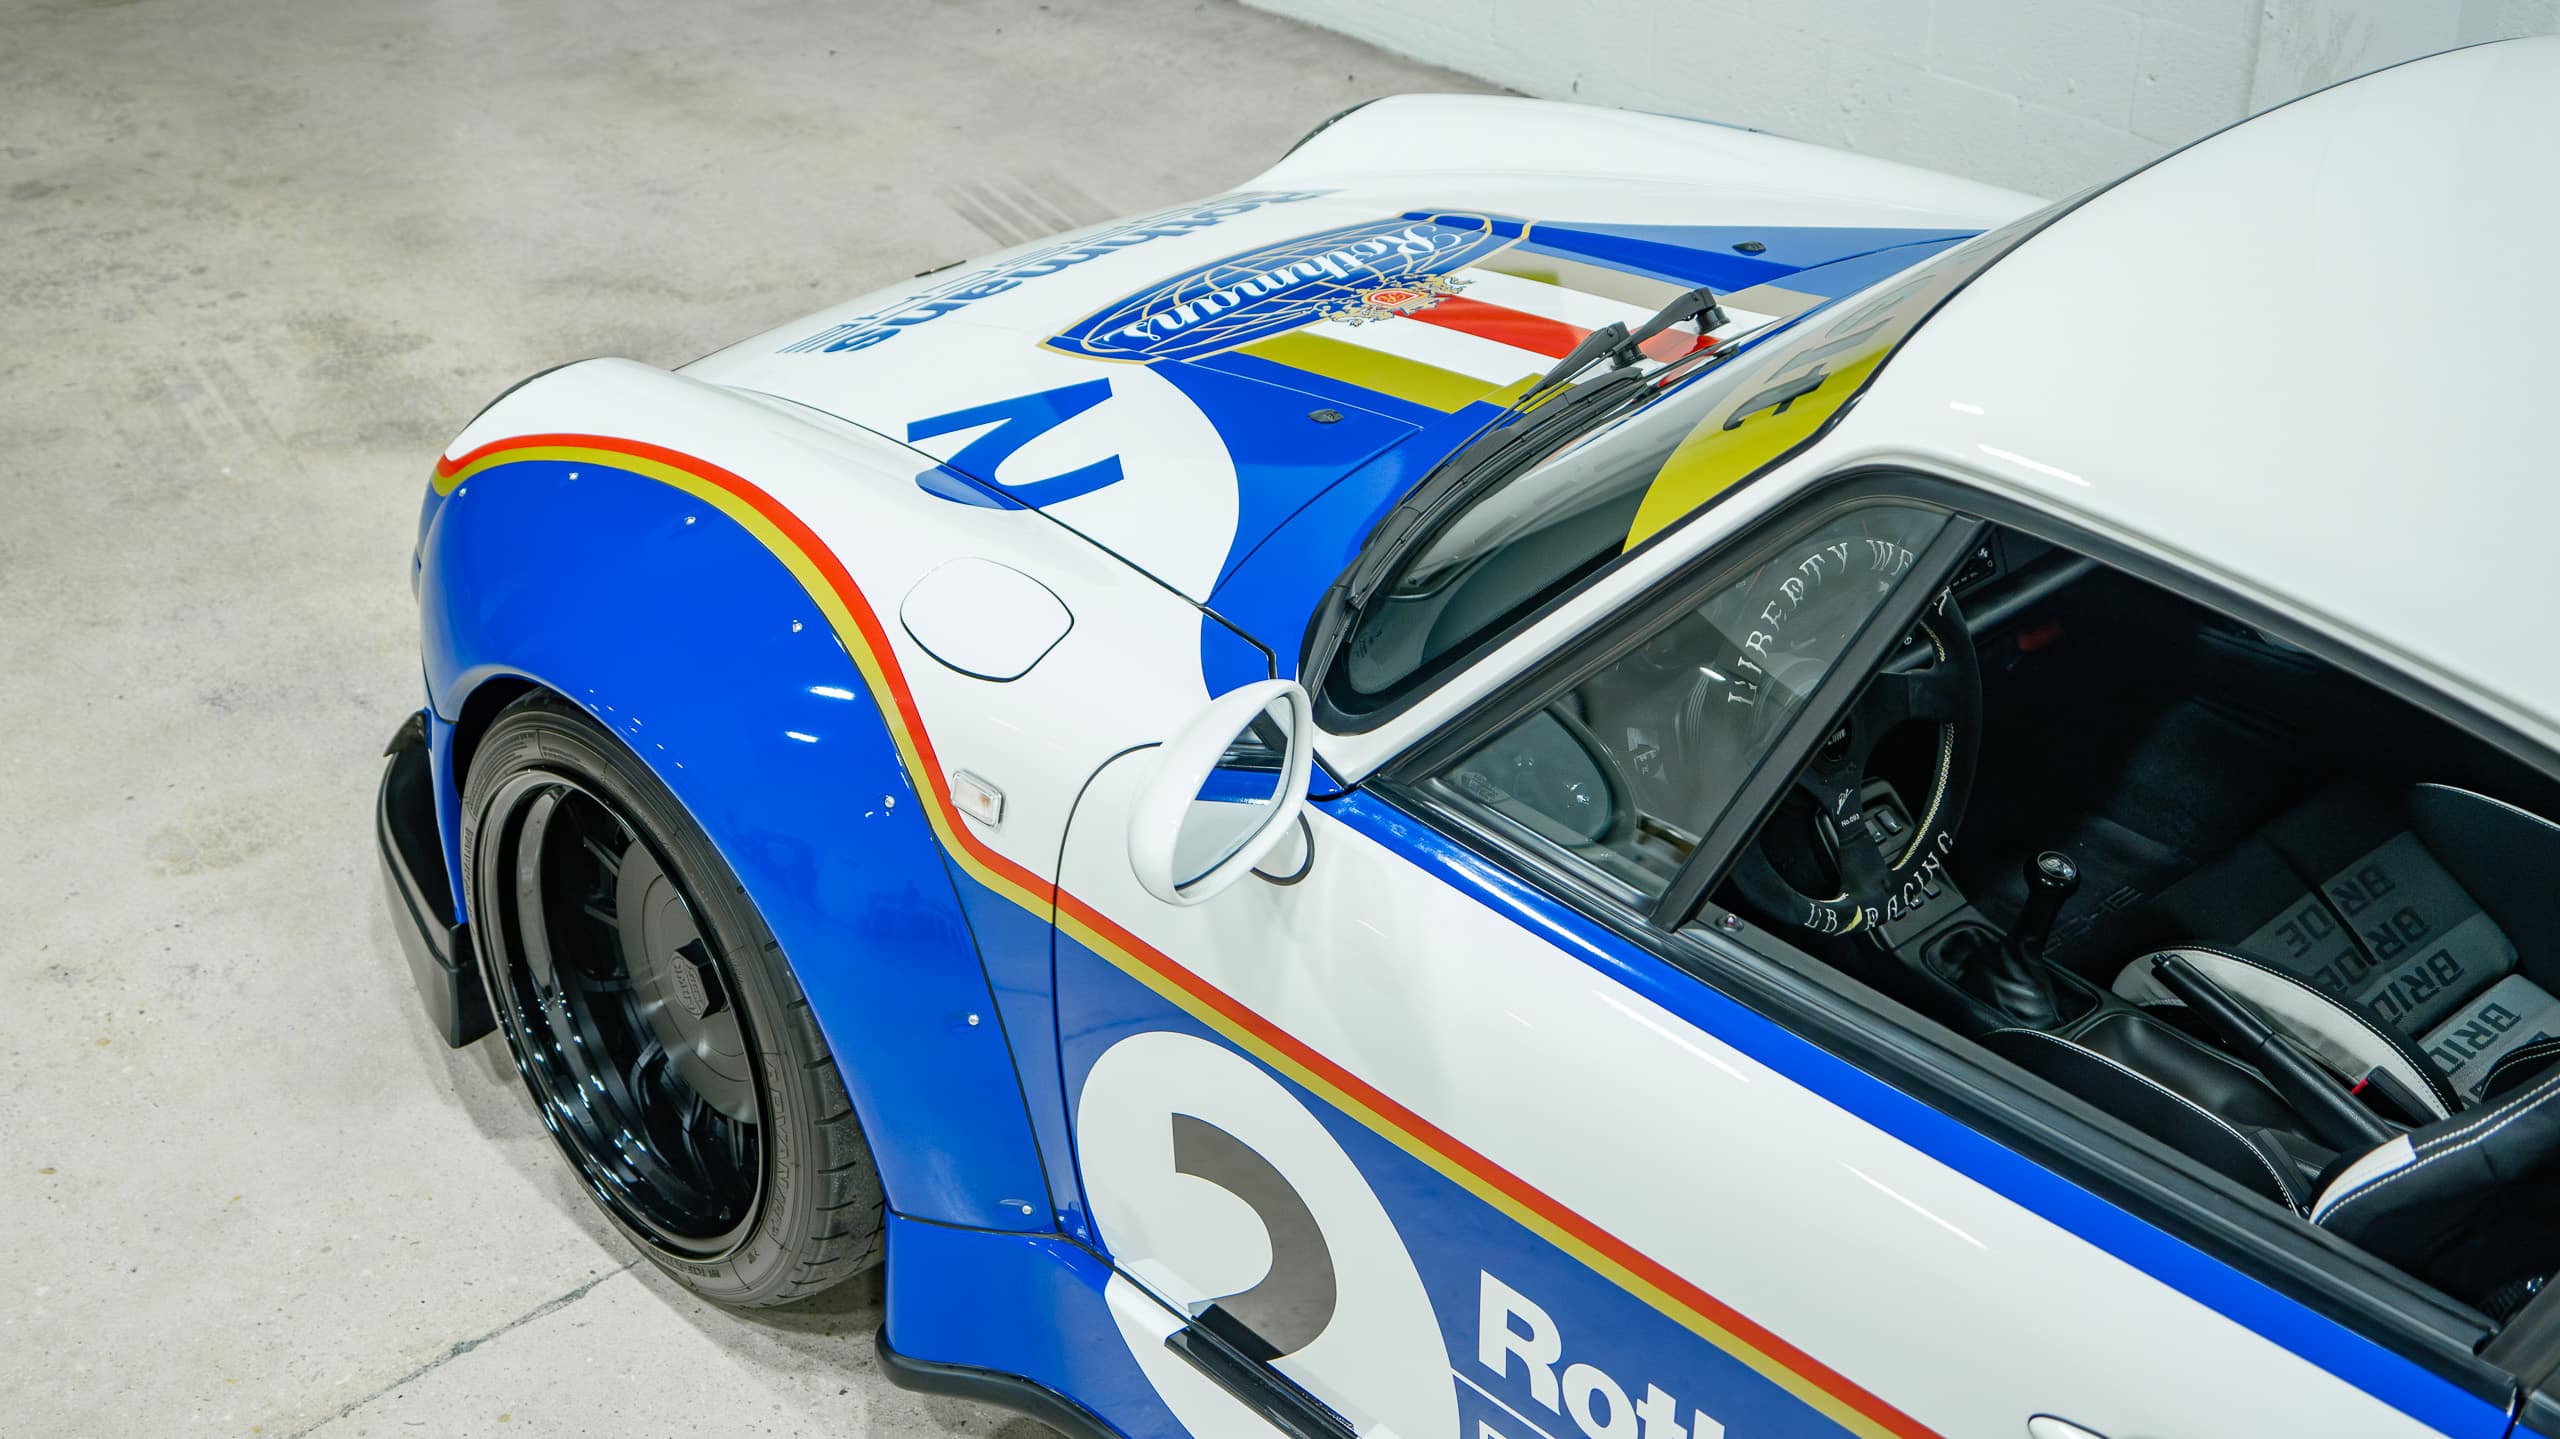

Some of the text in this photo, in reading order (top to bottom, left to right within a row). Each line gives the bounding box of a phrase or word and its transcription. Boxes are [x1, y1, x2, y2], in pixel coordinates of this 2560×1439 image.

[822, 187, 1346, 354] Rothmans
[1102, 224, 1462, 342] Rothmans
[906, 376, 1125, 512] 2
[1727, 541, 1848, 707] LIBERTY
[2275, 863, 2396, 958] BRDE
